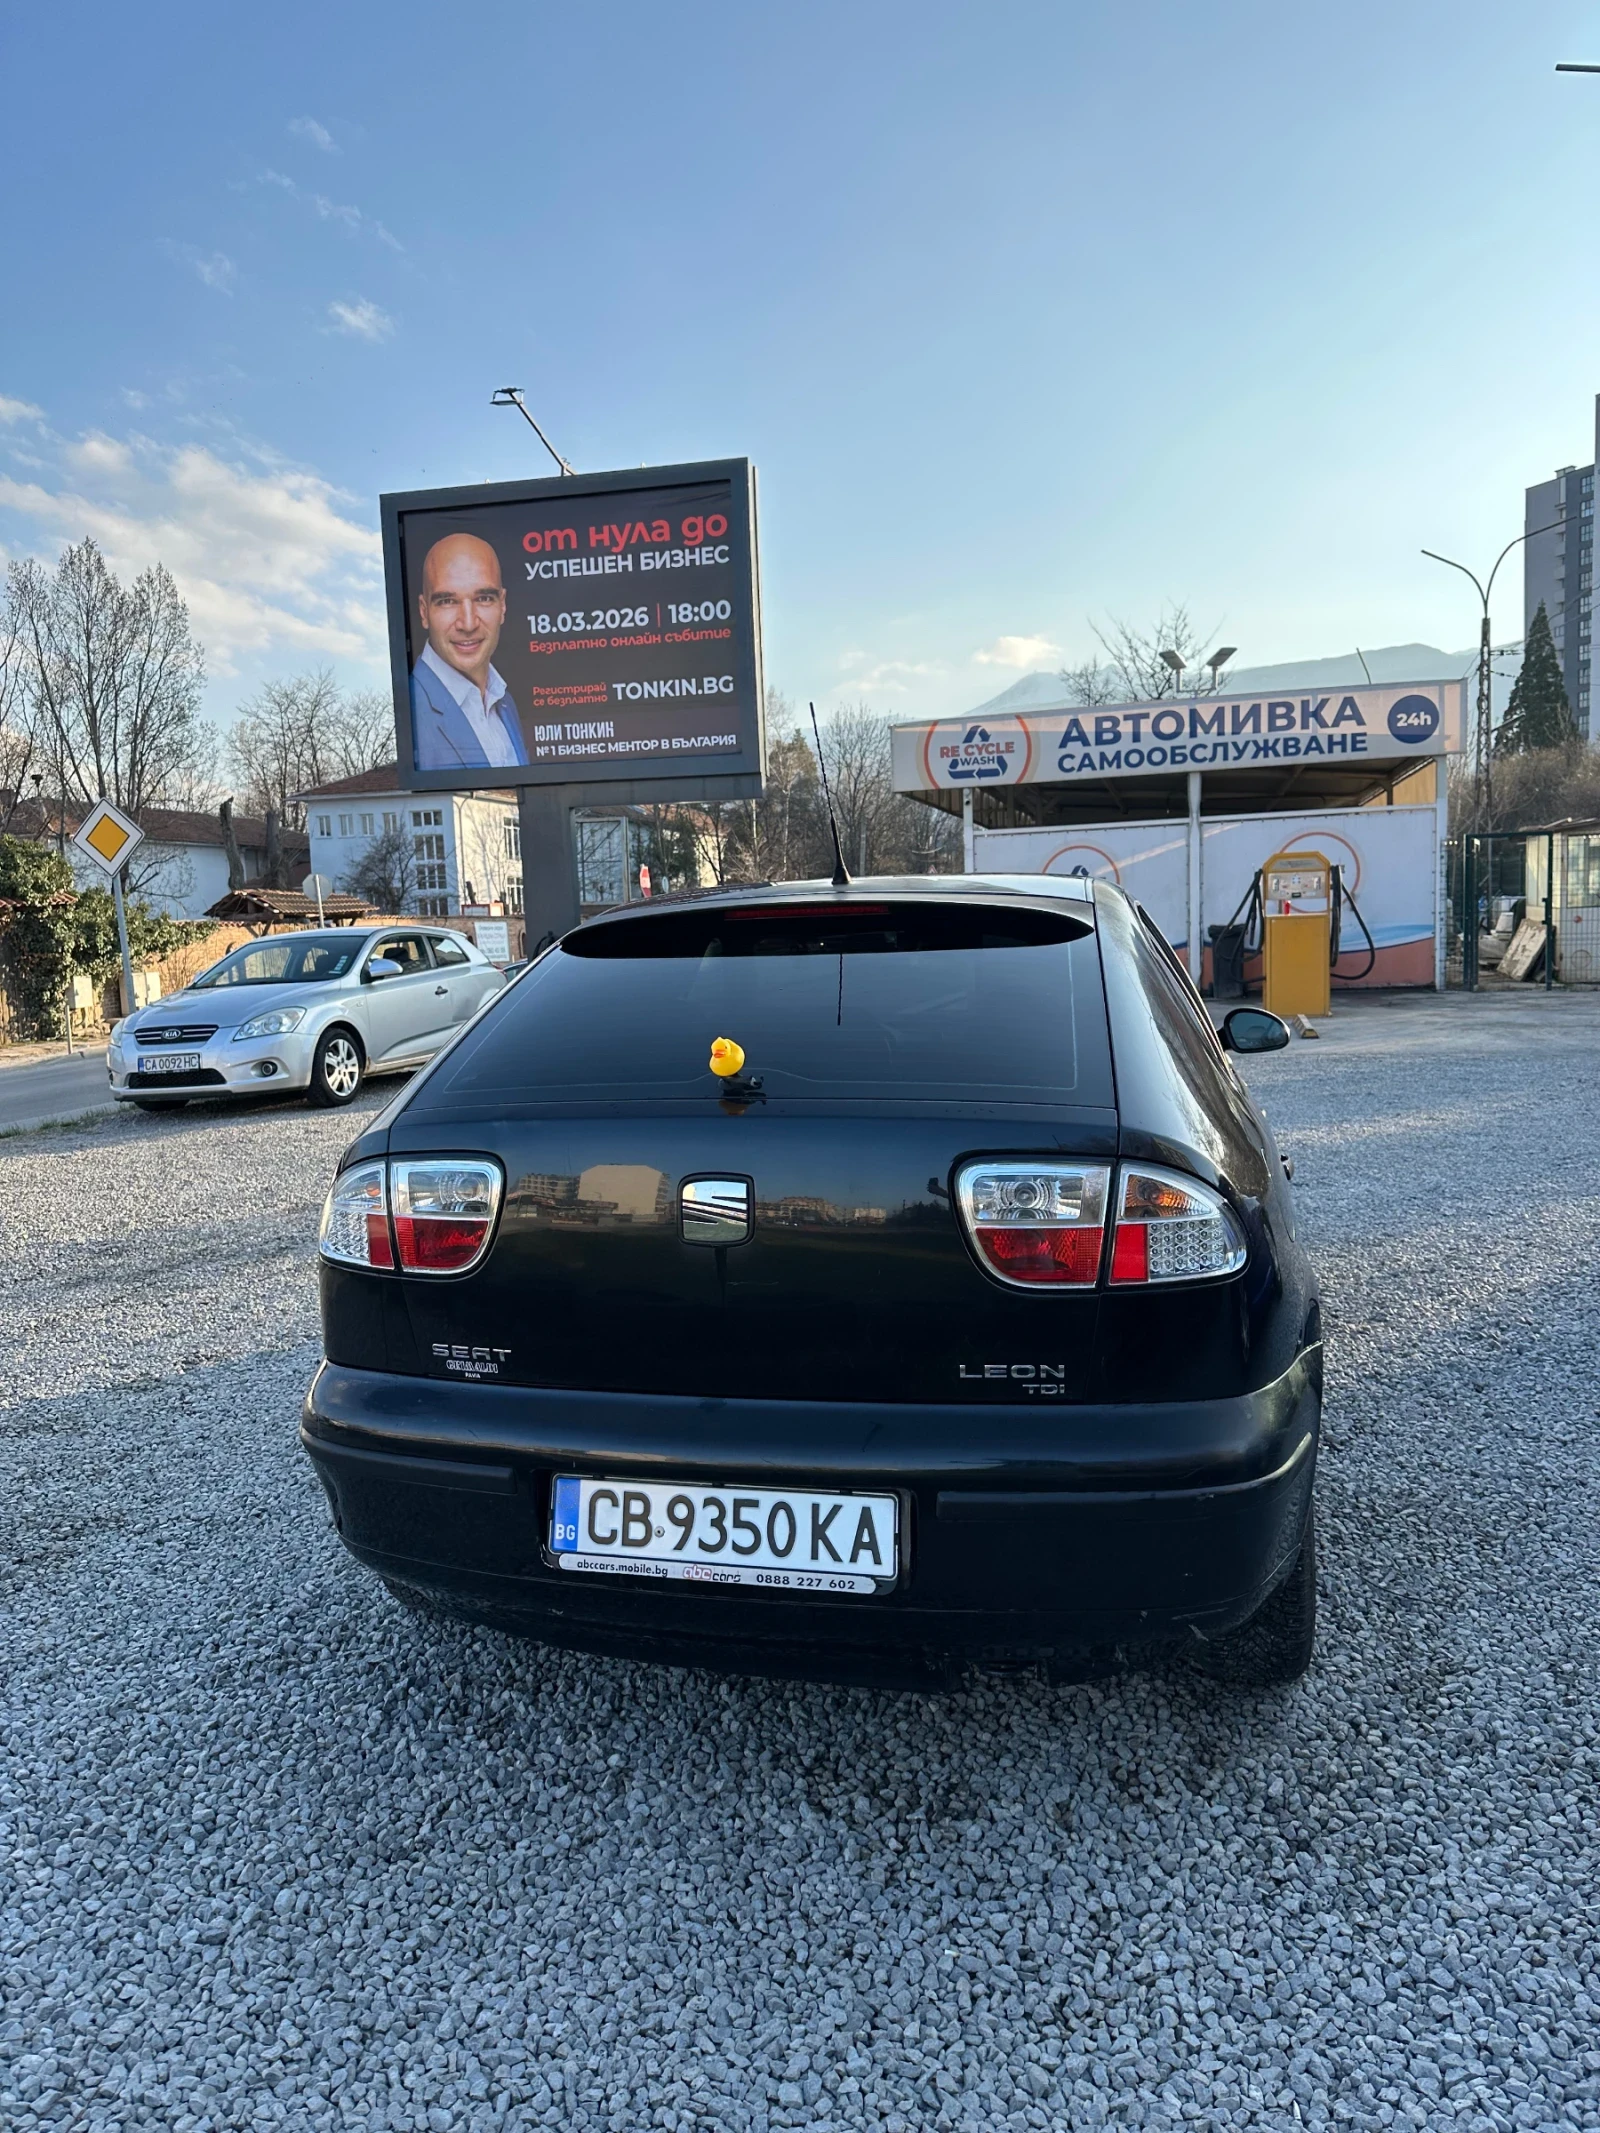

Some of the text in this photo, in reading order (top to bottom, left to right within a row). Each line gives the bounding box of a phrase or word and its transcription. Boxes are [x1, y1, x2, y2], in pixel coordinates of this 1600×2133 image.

[522, 514, 728, 553] от нула до
[524, 545, 730, 581] УСПЕШЕН БИЗНЕС
[527, 599, 732, 635] 18.03.2026 18:00
[529, 628, 732, 654] Безплатно онлайн събитие
[532, 682, 607, 696] Регистрирай
[612, 675, 734, 701] TONKIN.BG
[533, 694, 608, 707] се безплатно
[1058, 696, 1367, 749] АВТОМИВКА
[1396, 711, 1432, 727] 24h
[534, 721, 614, 742] ЮЛИ ТОНКИН
[558, 742, 606, 756] БИЗНЕС
[608, 739, 658, 753] МЕНТОР
[661, 739, 669, 750] В
[671, 734, 737, 749] БЪЛГАРИЯ
[940, 742, 1015, 758] RE CYCLE
[1058, 732, 1368, 773] САМООБСЛУЖВАНЕ
[960, 756, 995, 767] WASH
[158, 1057, 182, 1070] 0092
[432, 1343, 512, 1362] SEAT
[959, 1364, 1065, 1378] LEON
[555, 1523, 577, 1542] BG
[666, 1494, 796, 1558] 9350
[810, 1502, 883, 1566] KA
[577, 1559, 668, 1578] abccars.mobile.bg
[756, 1574, 790, 1585] 0888
[797, 1577, 823, 1588] 227
[829, 1579, 855, 1590] 602
